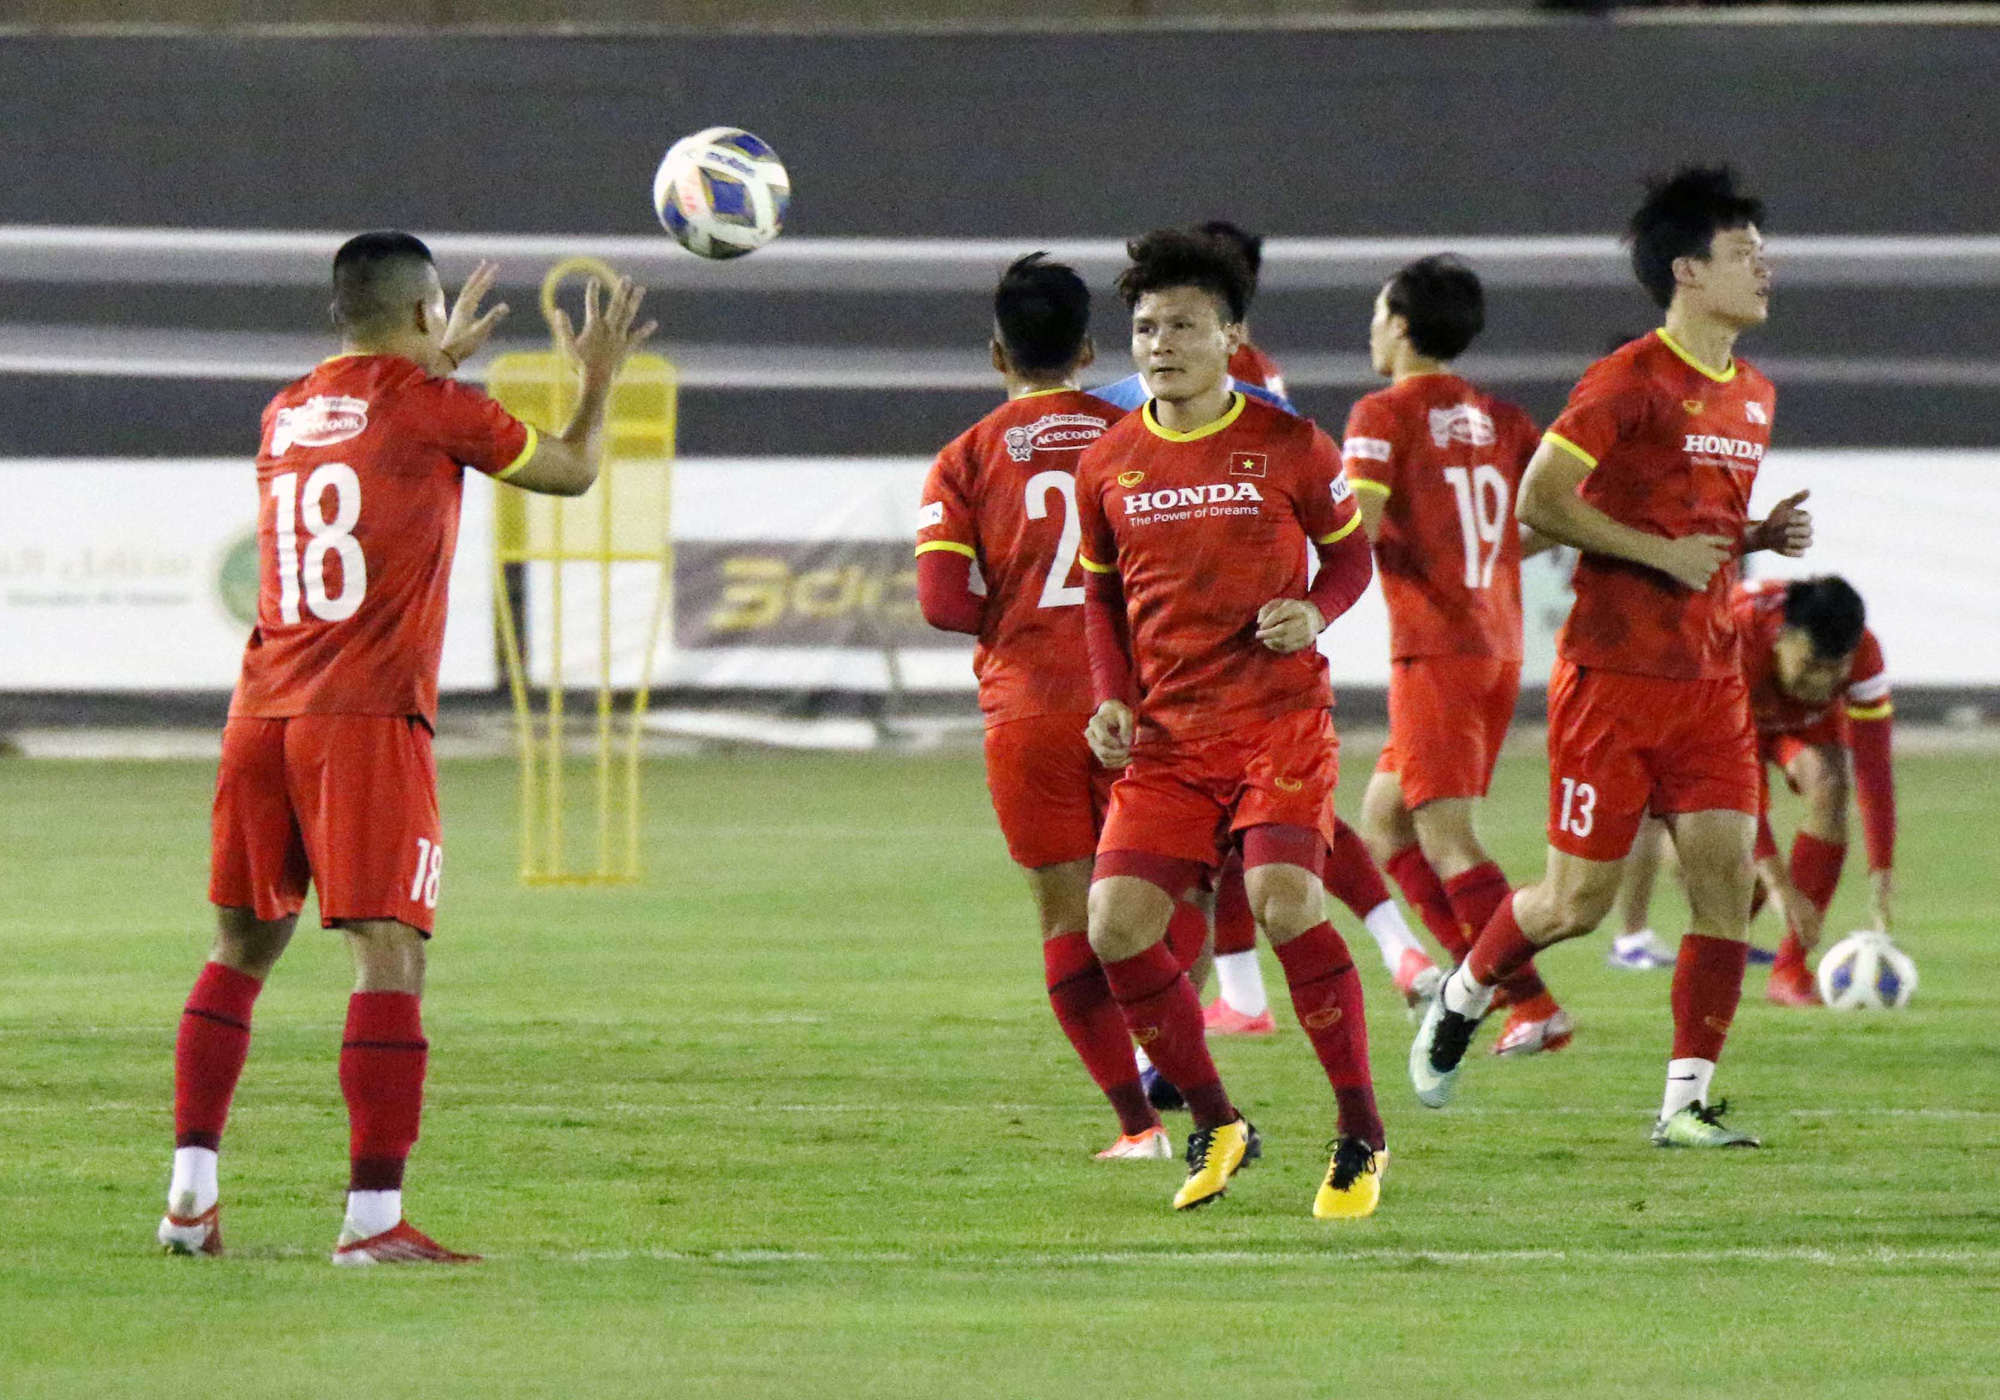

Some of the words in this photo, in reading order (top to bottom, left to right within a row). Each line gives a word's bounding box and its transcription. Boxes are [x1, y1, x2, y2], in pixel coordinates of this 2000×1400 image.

[1682, 434, 1763, 461] HONDA
[1123, 482, 1264, 515] HONDA
[1130, 516, 1151, 527] The
[1153, 509, 1191, 524] Power
[1194, 507, 1208, 518] of
[1210, 505, 1259, 518] Dreams
[1443, 464, 1509, 588] 19
[271, 462, 367, 625] 18
[1025, 470, 1086, 608] 2
[1560, 777, 1595, 837] 13
[410, 836, 443, 909] 18
